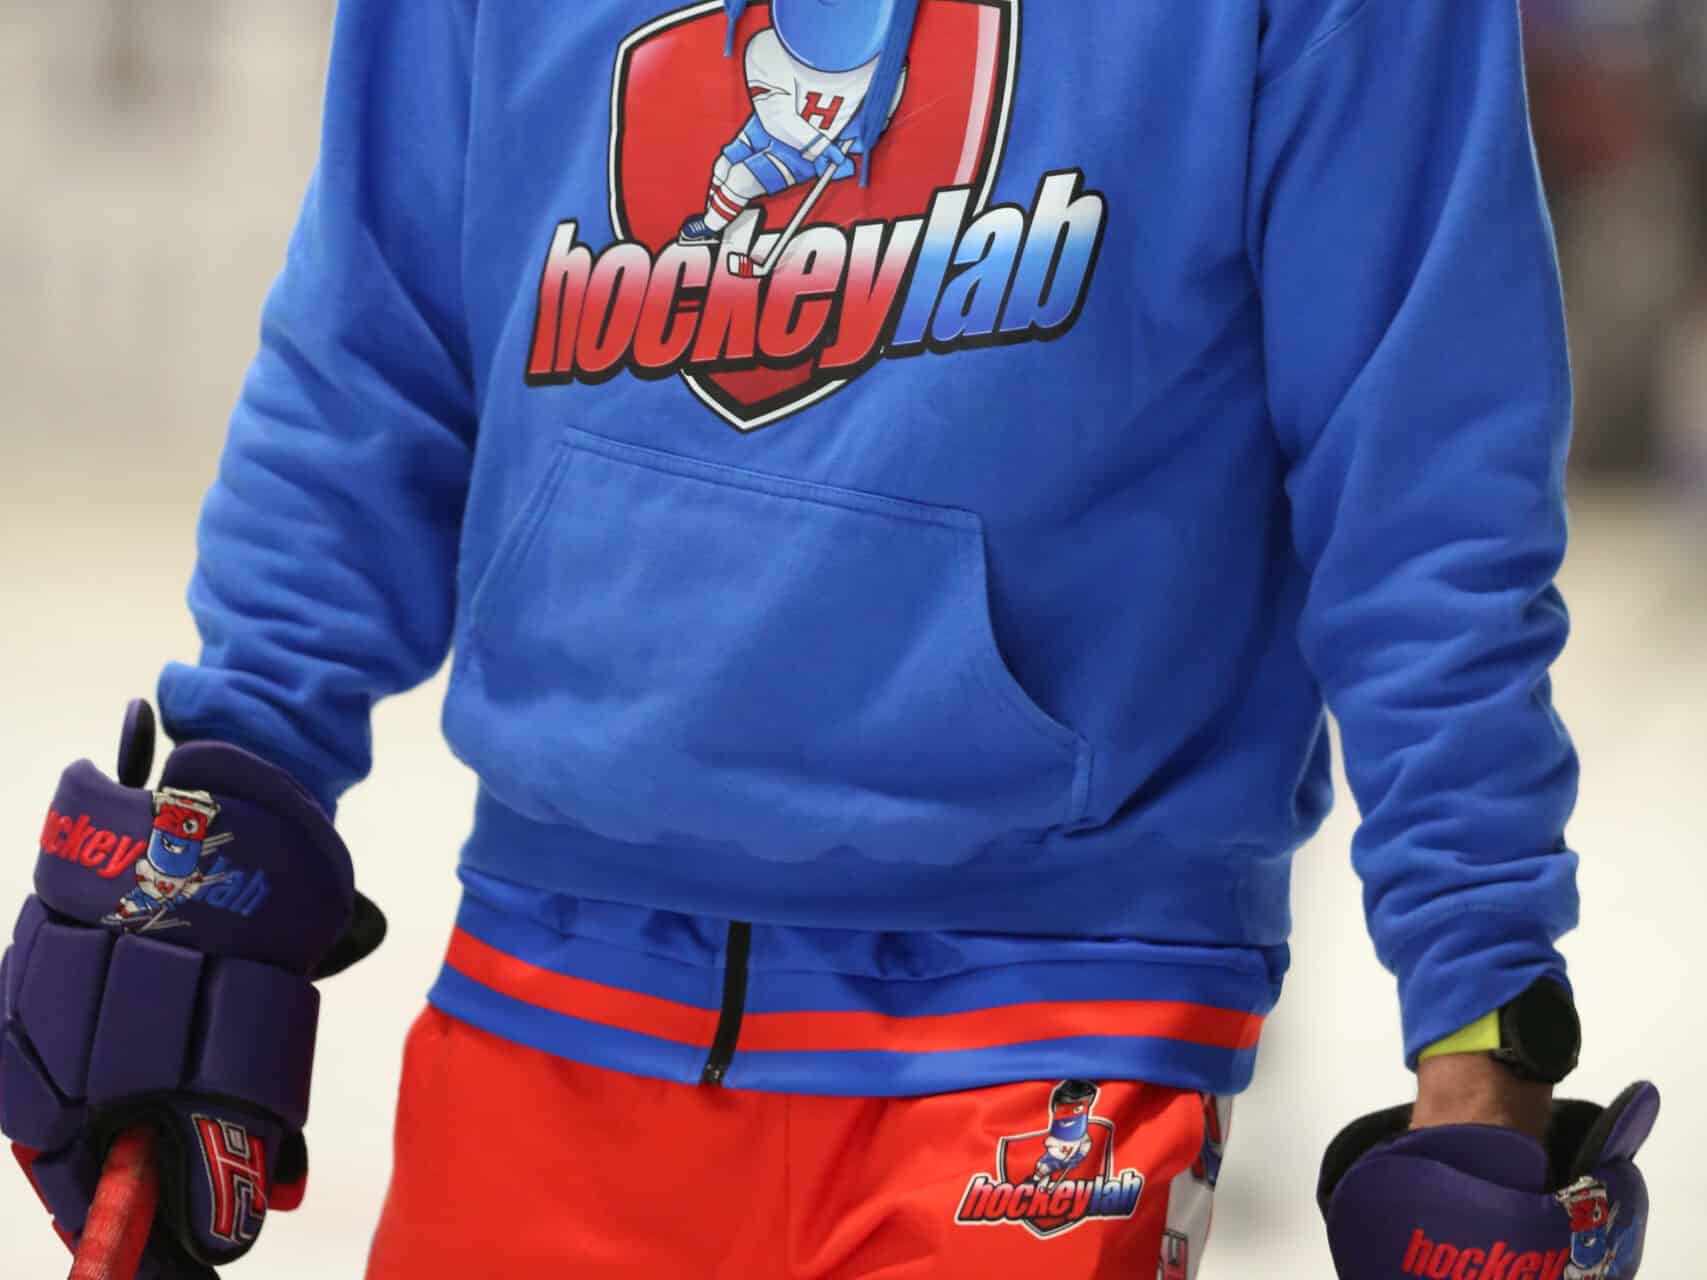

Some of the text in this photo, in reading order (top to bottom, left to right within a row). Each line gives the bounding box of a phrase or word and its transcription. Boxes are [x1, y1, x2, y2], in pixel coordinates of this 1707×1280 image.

[801, 91, 844, 130] H
[525, 168, 1107, 386] hockeylab
[959, 1171, 1143, 1220] hockeylab
